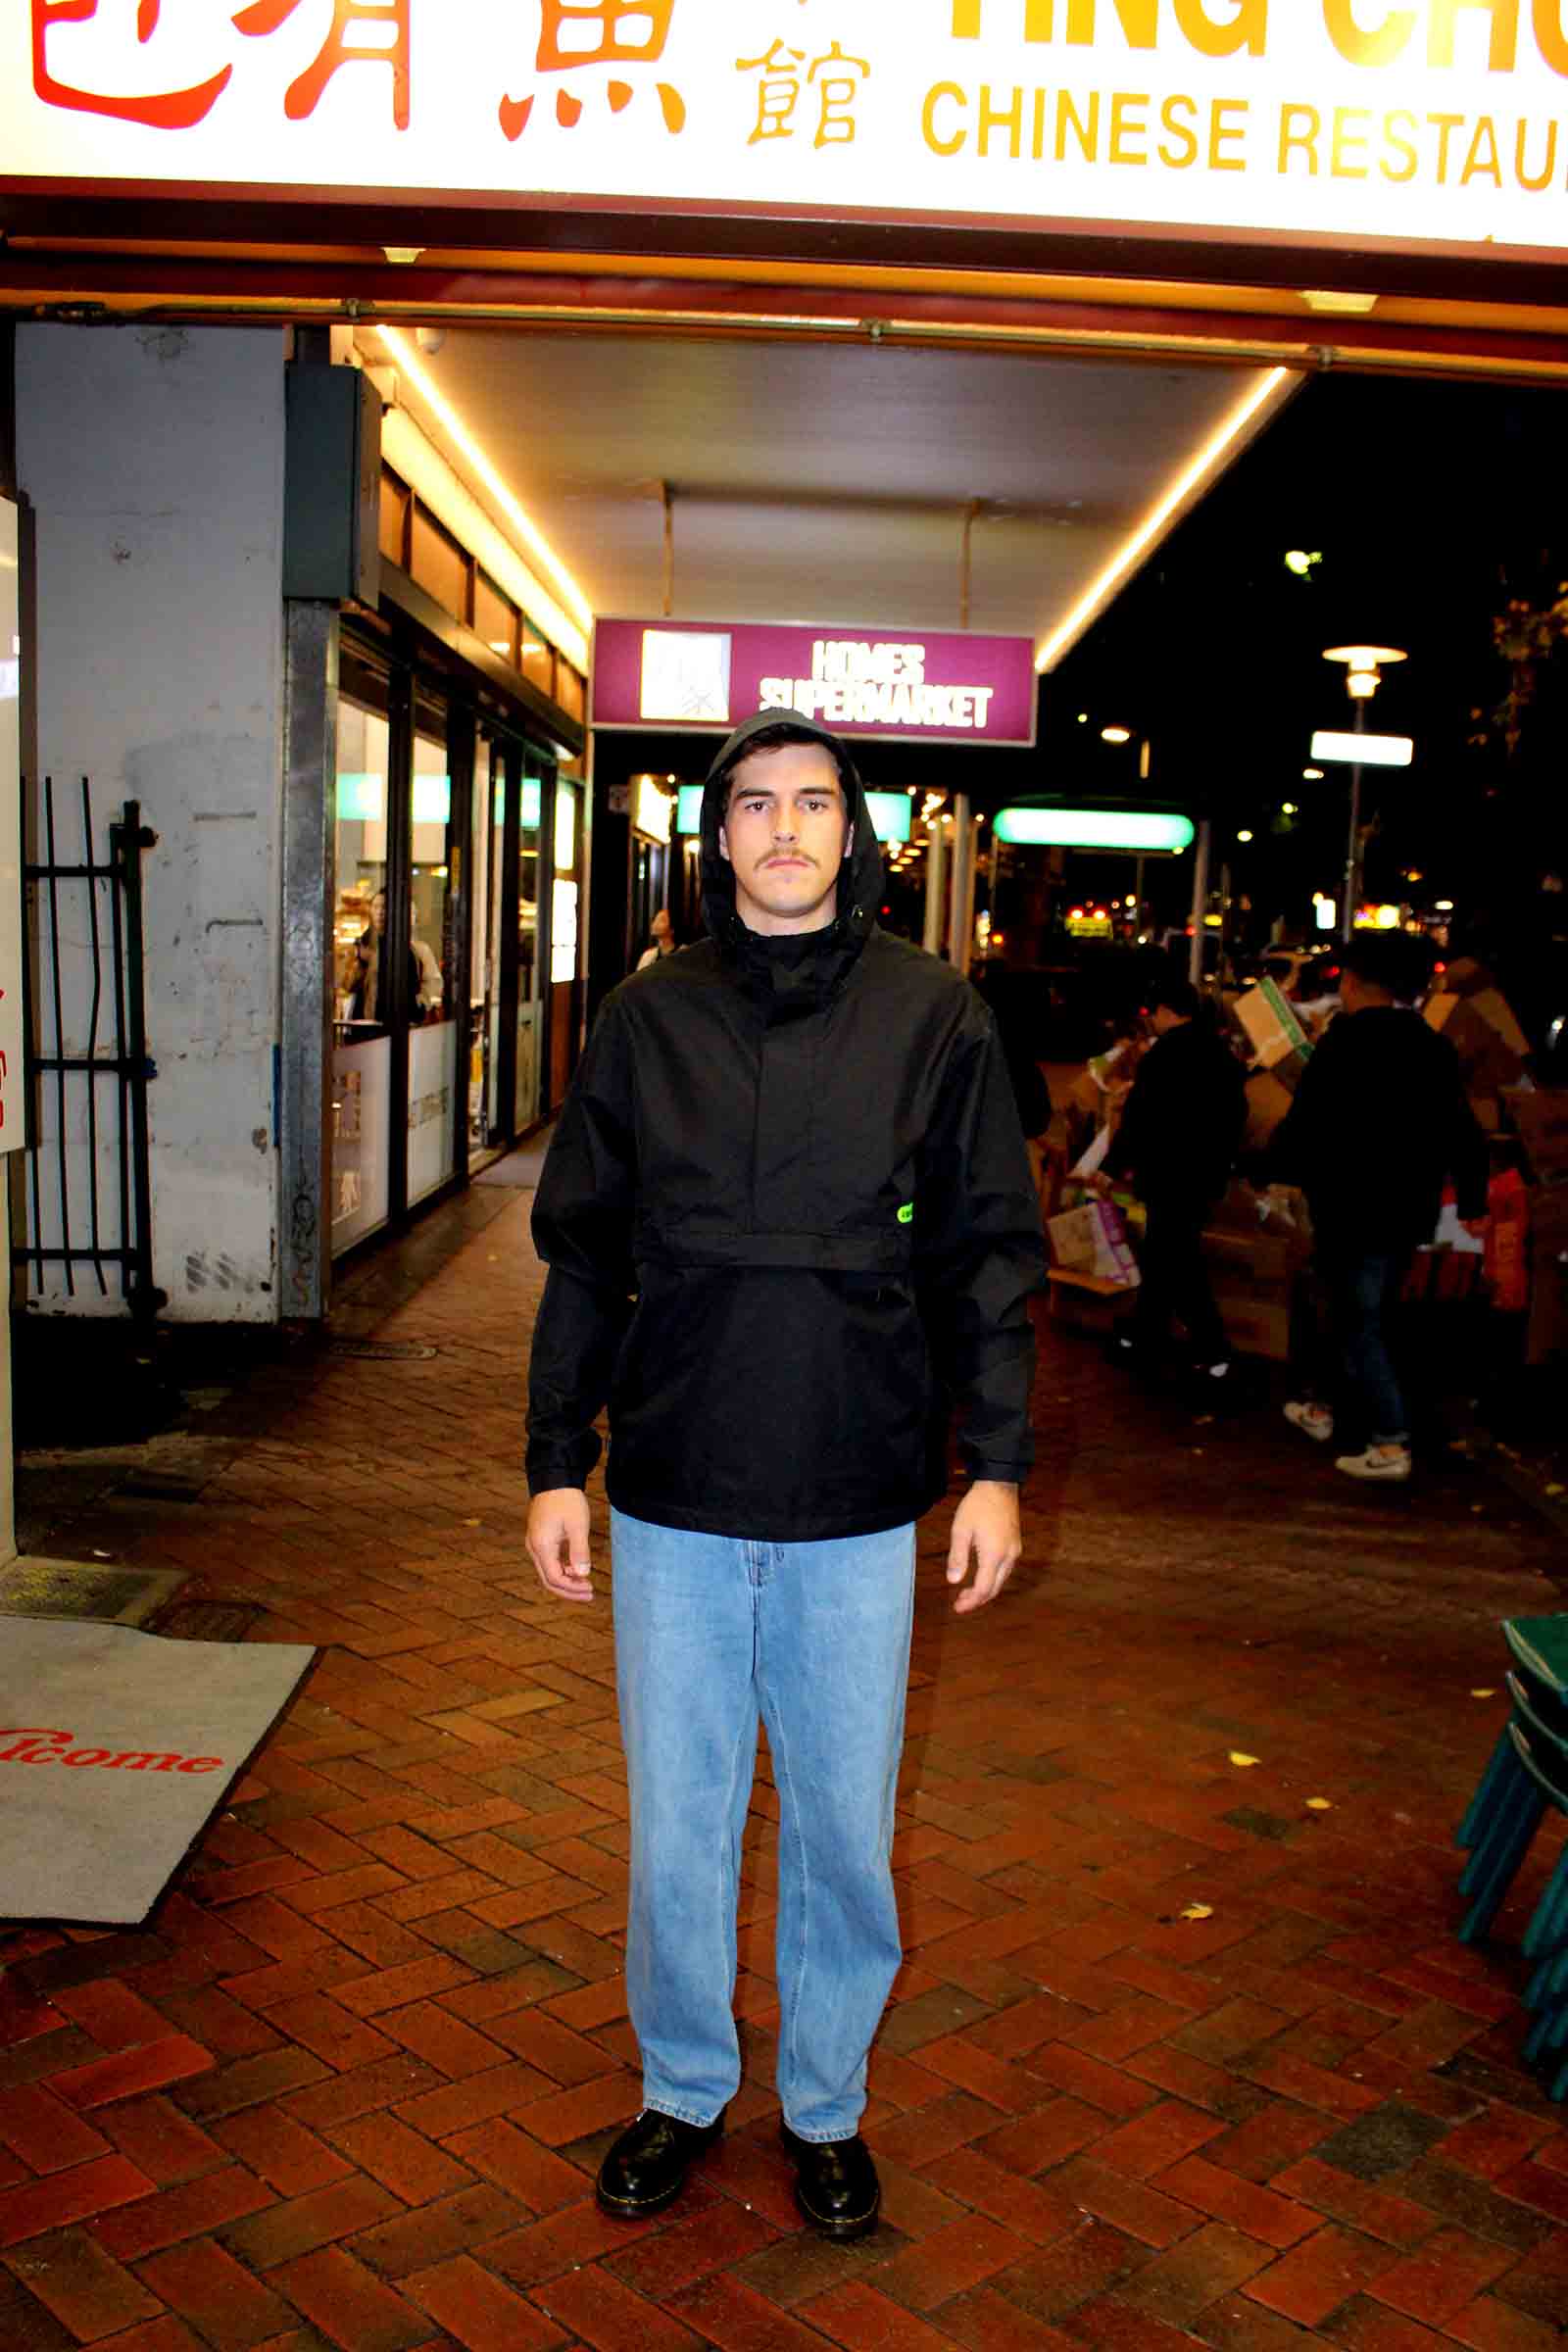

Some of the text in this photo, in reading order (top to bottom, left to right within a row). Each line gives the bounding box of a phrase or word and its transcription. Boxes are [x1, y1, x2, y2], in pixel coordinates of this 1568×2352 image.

[921, 80, 1568, 192] CHINESE RESTAU
[760, 677, 994, 728] SUPERMARKET
[0, 1728, 224, 1773] lcome
